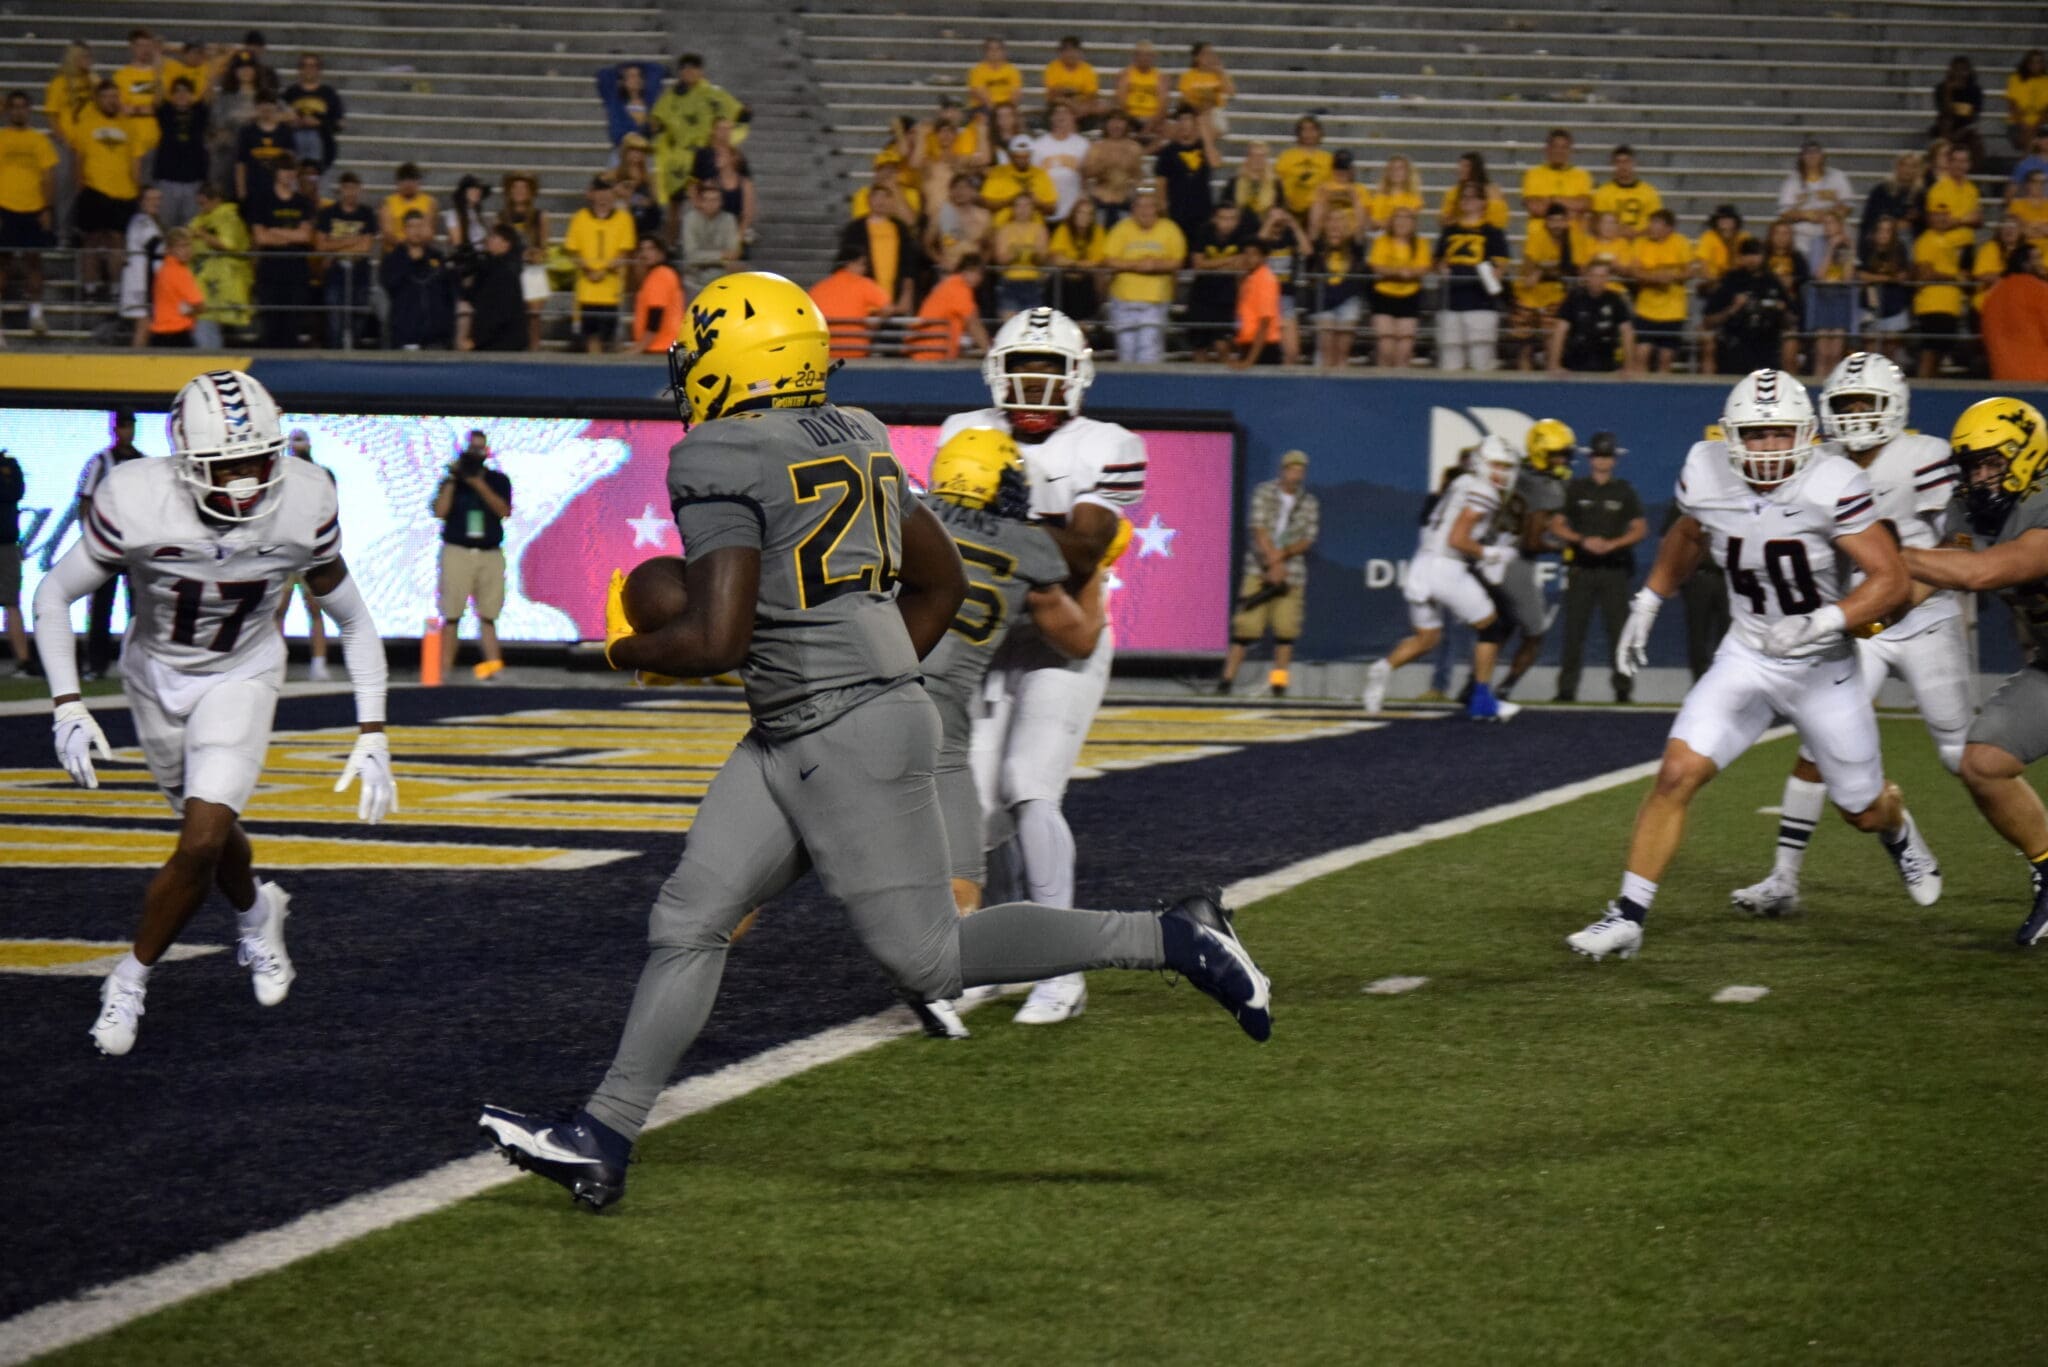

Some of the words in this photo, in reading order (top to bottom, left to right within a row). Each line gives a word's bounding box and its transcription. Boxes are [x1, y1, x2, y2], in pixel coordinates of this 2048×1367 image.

[795, 370, 815, 387] 20
[787, 451, 901, 610] 20
[170, 577, 269, 653] 17
[1726, 536, 1822, 616] 40
